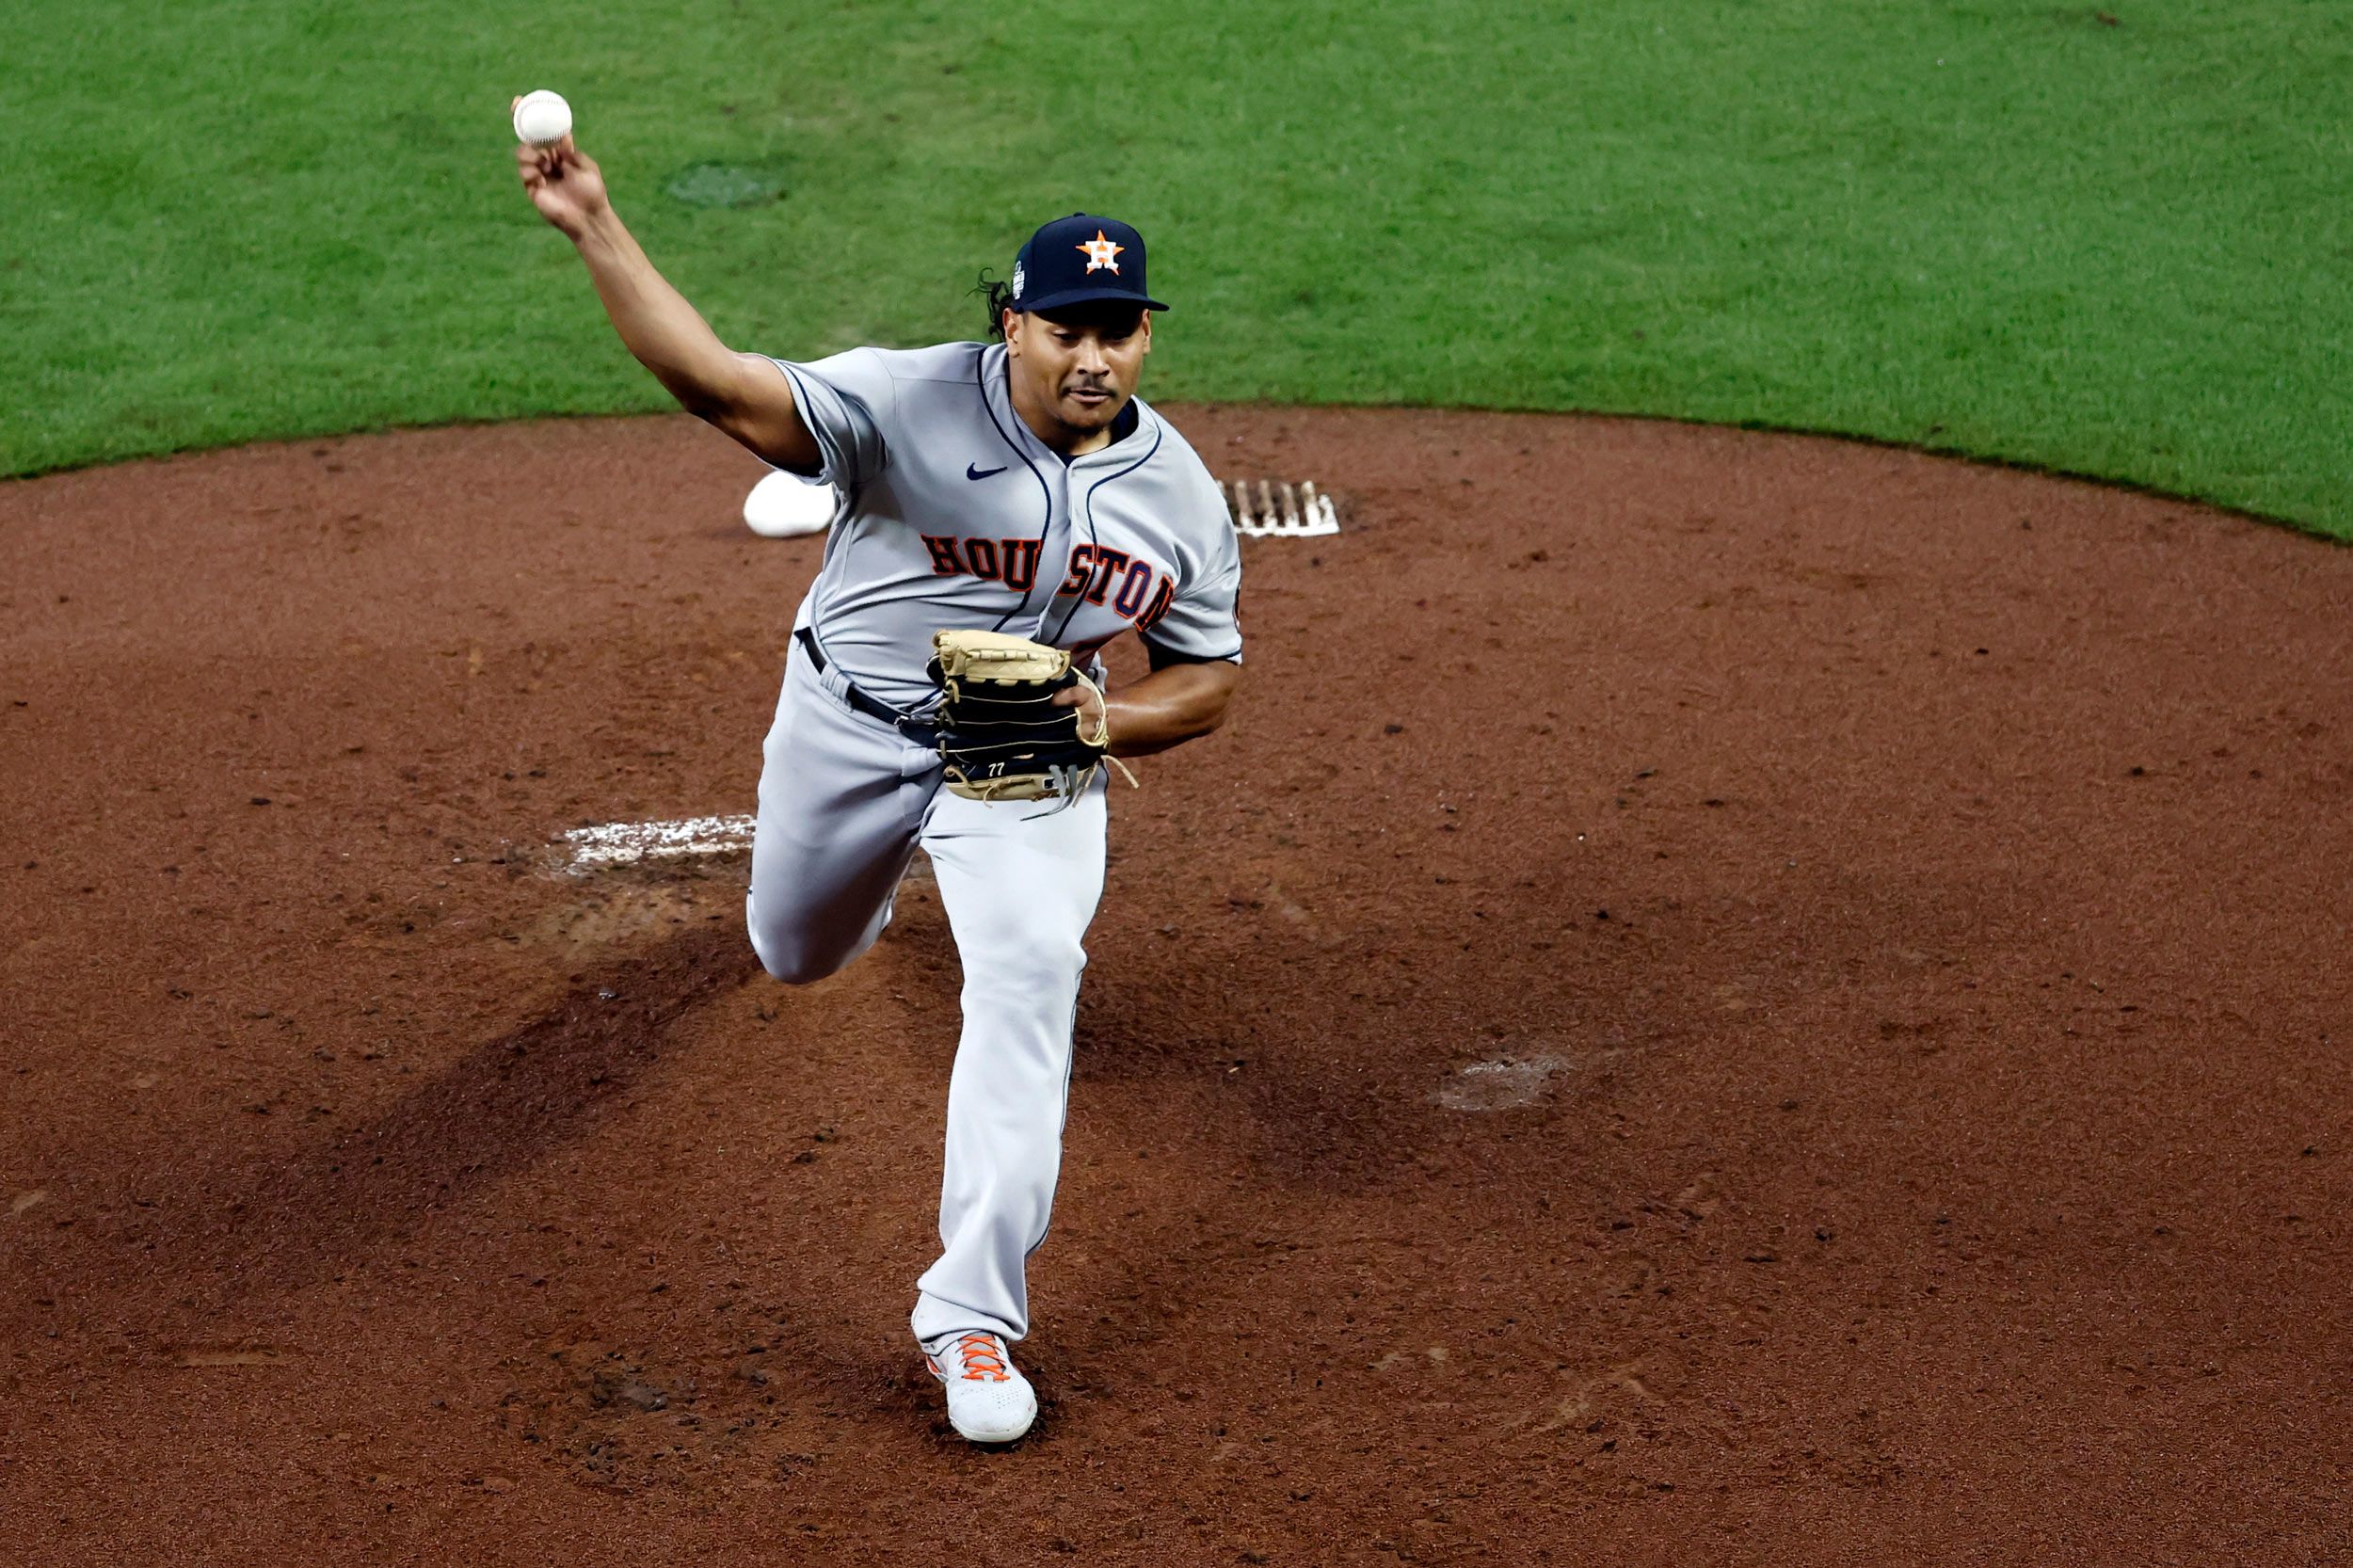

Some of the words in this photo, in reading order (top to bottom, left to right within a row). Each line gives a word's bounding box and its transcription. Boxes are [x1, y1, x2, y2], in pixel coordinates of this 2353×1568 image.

[1085, 241, 1119, 270] H
[920, 534, 1175, 632] HOUSTON
[988, 761, 1005, 777] 77
